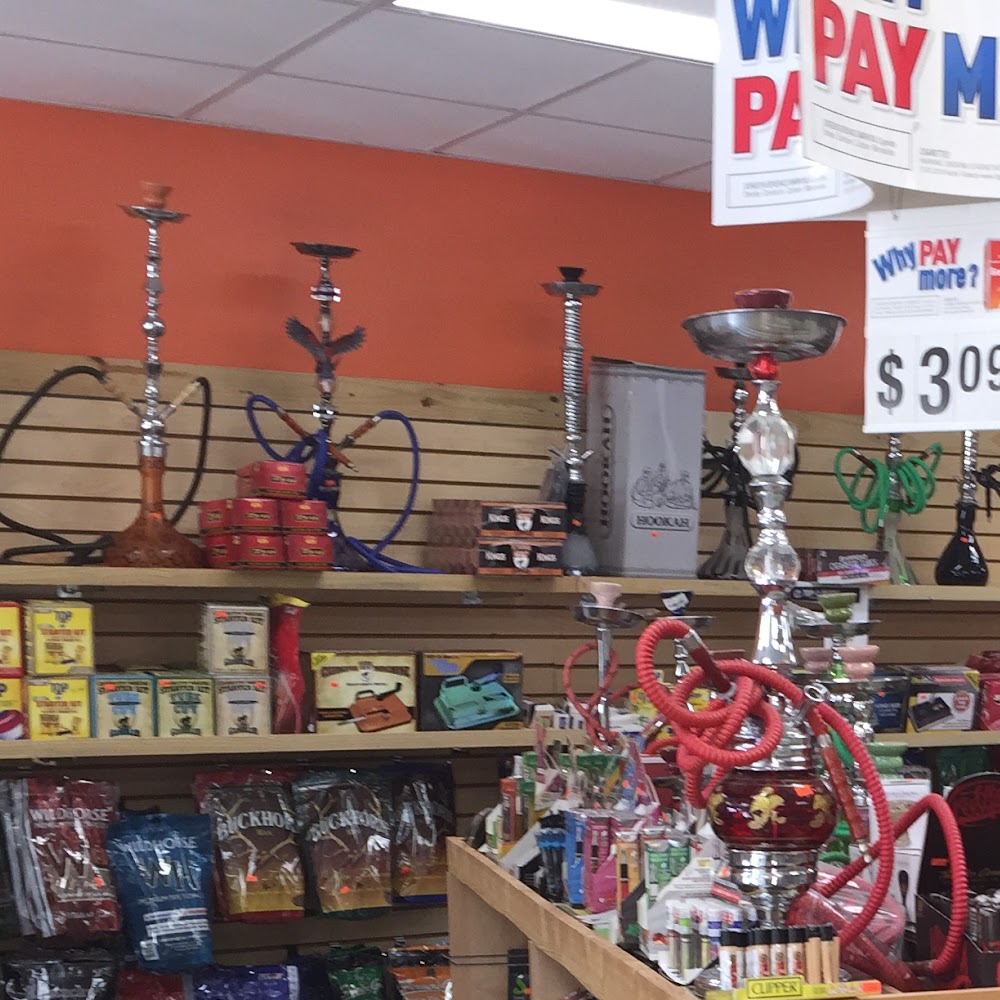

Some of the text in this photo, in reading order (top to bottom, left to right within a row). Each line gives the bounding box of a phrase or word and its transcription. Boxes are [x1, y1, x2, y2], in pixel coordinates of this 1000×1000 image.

[813, 0, 928, 111] PAY
[733, 70, 801, 154] PA
[872, 238, 961, 282] Why PAY
[636, 515, 690, 529] HOOKAH
[751, 982, 798, 996] CLIPPER
